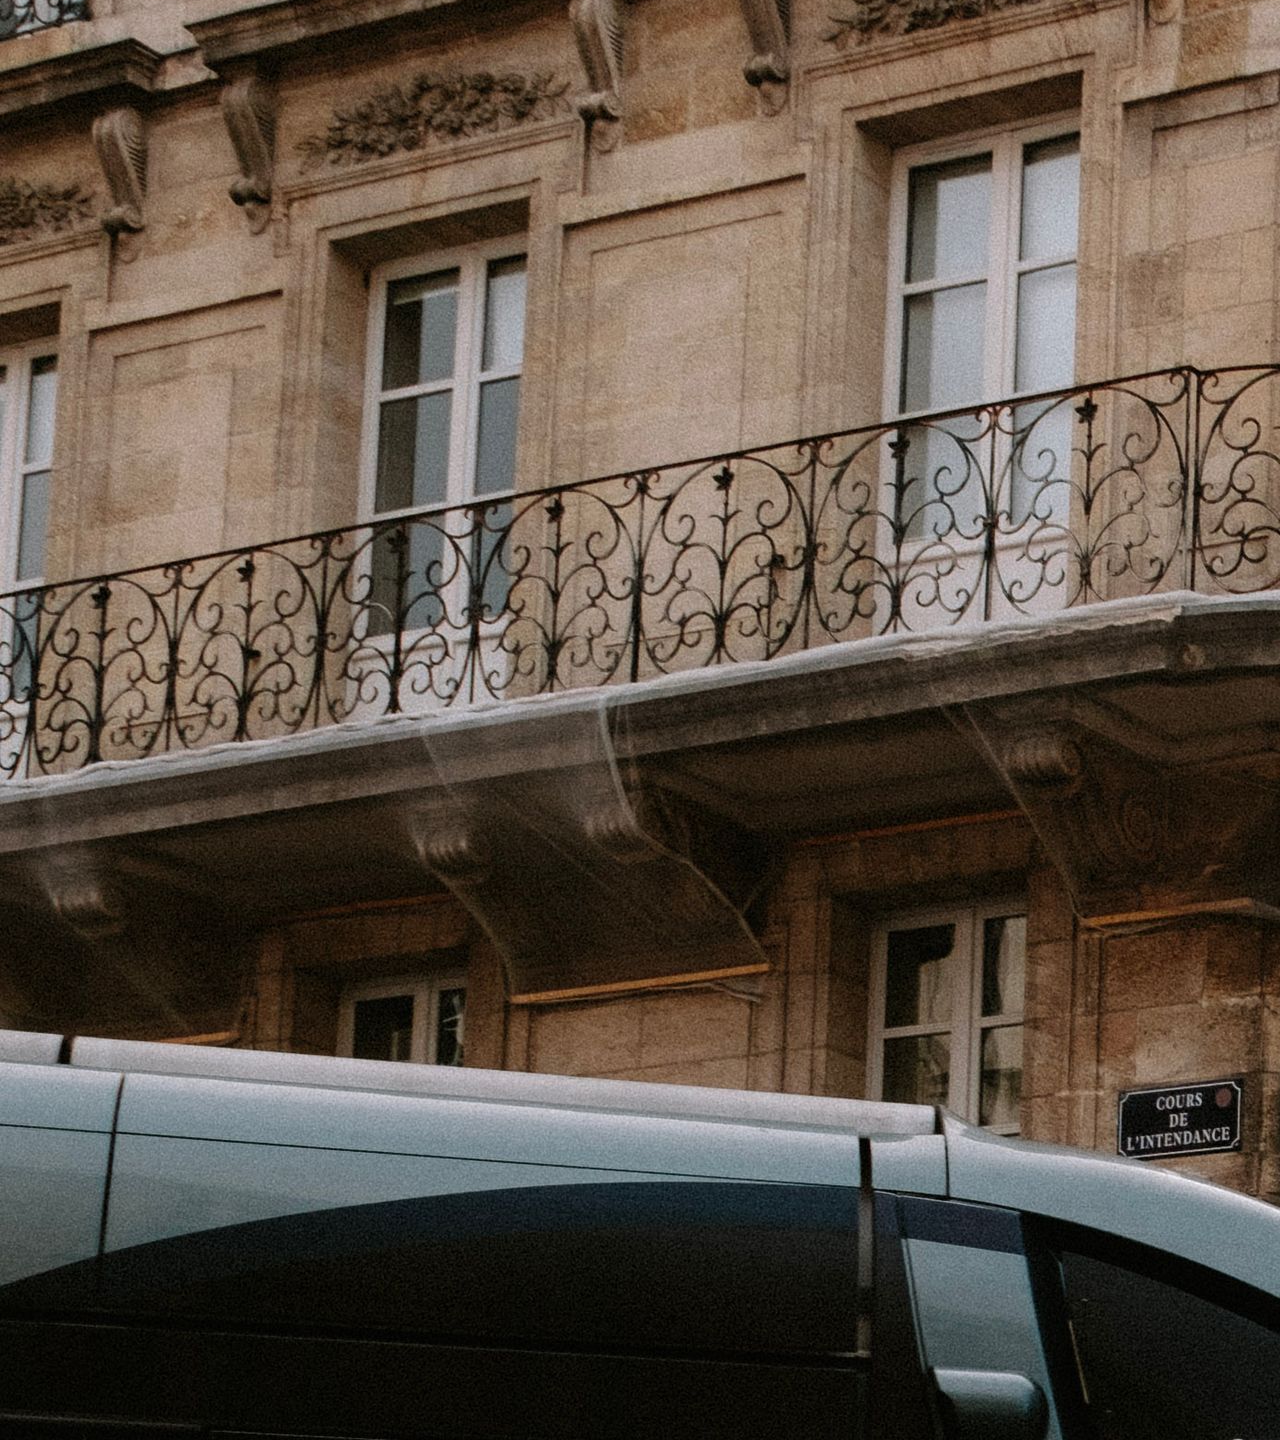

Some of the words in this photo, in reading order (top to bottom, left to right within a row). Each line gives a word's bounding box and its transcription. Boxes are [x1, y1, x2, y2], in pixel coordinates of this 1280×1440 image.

[1156, 1092, 1203, 1111] COURS
[1168, 1112, 1189, 1128] DE
[1126, 1126, 1231, 1151] L'INTENDANCE
